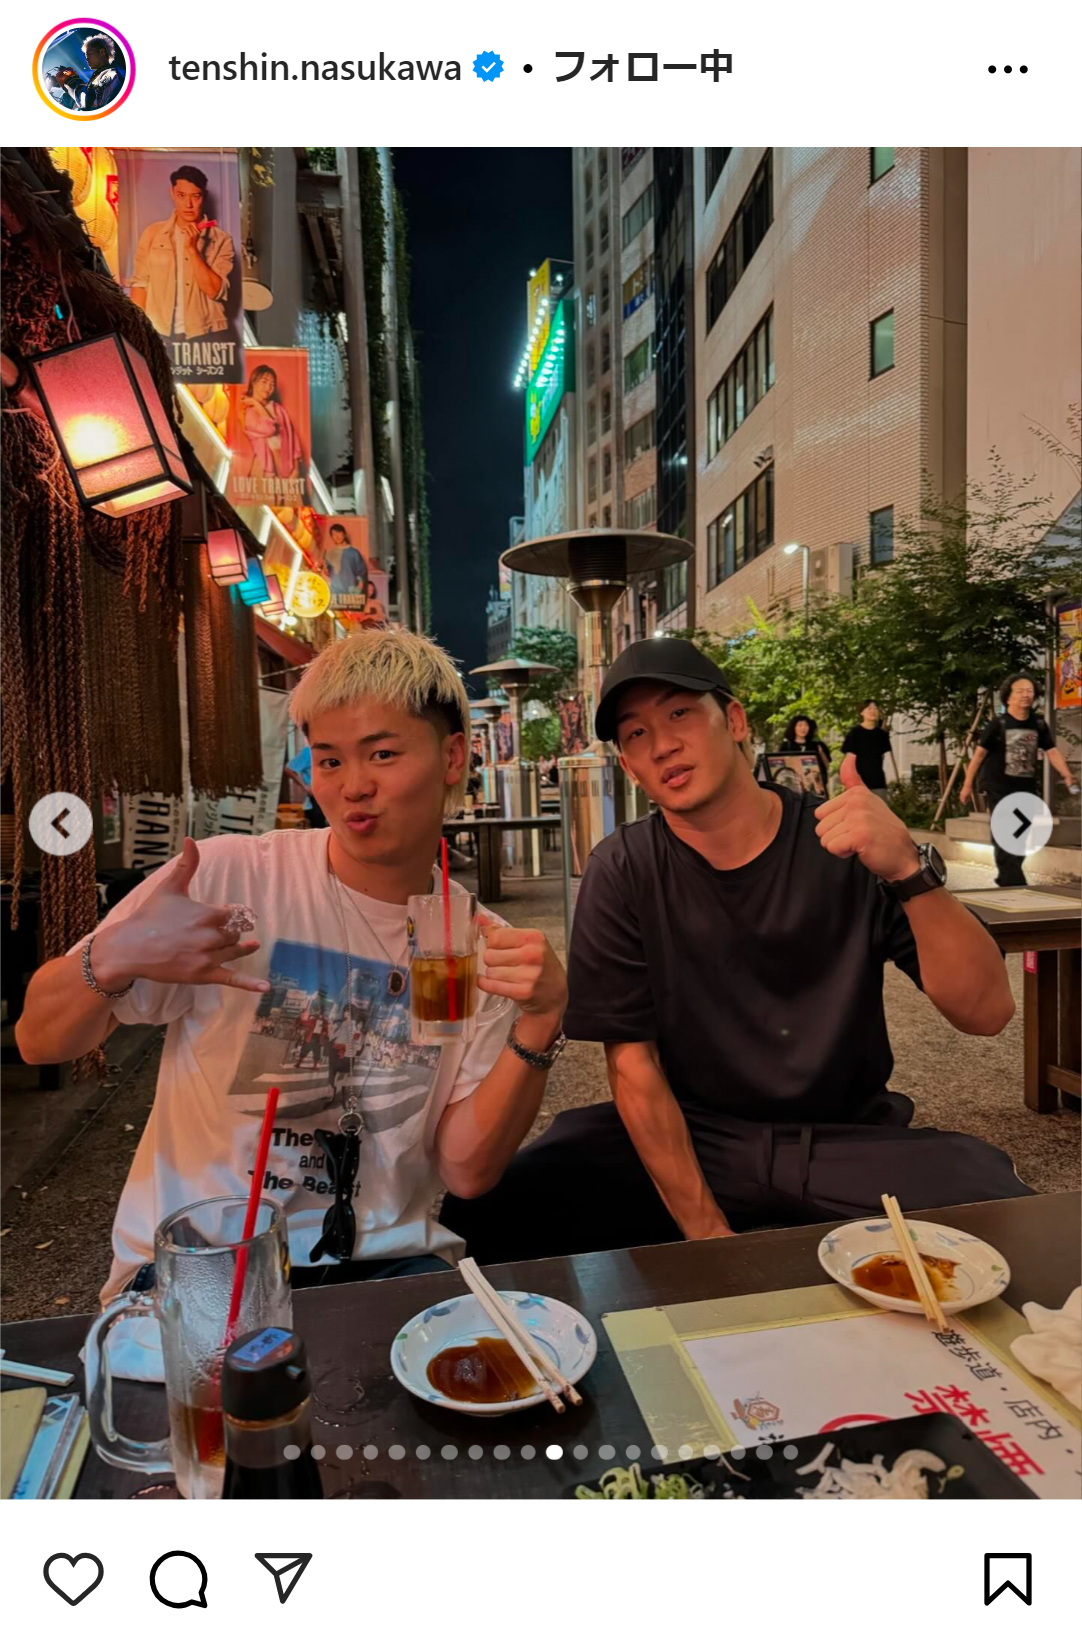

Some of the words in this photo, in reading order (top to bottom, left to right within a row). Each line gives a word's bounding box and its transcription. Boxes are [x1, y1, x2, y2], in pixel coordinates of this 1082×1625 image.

[172, 341, 236, 366] TRANSIT
[233, 476, 258, 493] LOVE
[261, 477, 306, 495] TRANSIT
[271, 1128, 314, 1147] The
[299, 1154, 326, 1169] and
[303, 1175, 362, 1198] Beat
